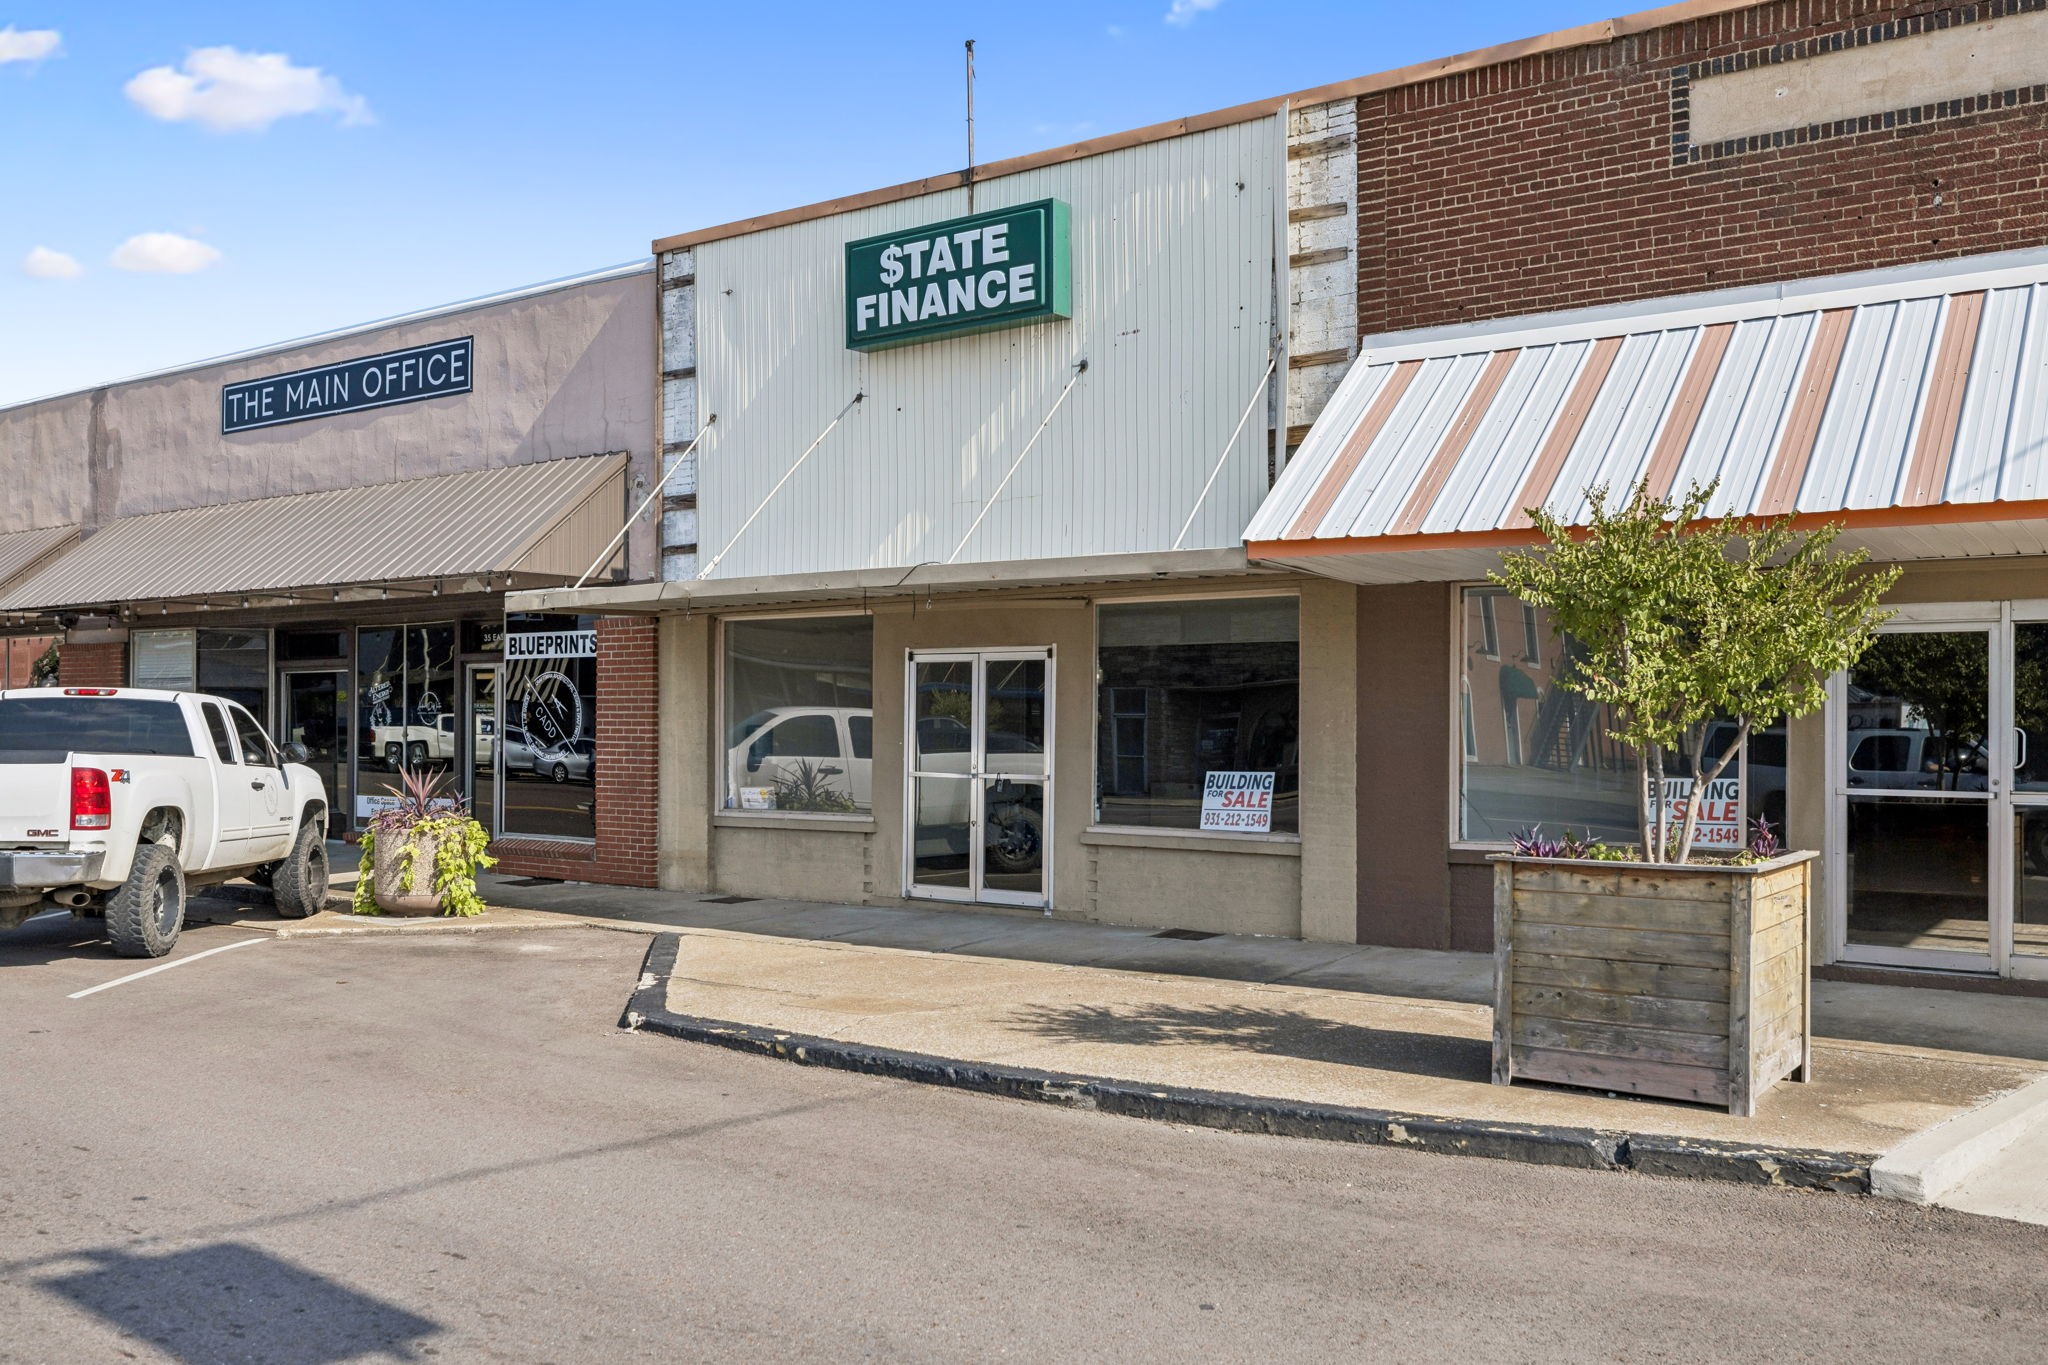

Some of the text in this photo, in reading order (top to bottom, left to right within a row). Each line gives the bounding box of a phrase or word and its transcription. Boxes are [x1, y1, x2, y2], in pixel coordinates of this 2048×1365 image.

[880, 223, 1009, 288] $TATE
[857, 264, 1036, 332] FINANCE
[228, 349, 465, 422] THE MAIN OFFICE
[483, 633, 491, 642] 35
[508, 633, 597, 656] BLUEPRINTS
[535, 707, 556, 738] CADD
[1206, 774, 1273, 790] BUILDING
[1207, 790, 1270, 808] FOR SALE
[1650, 801, 1672, 809] FR
[1204, 813, 1268, 828] 931-212-1549
[27, 829, 59, 837] GMC
